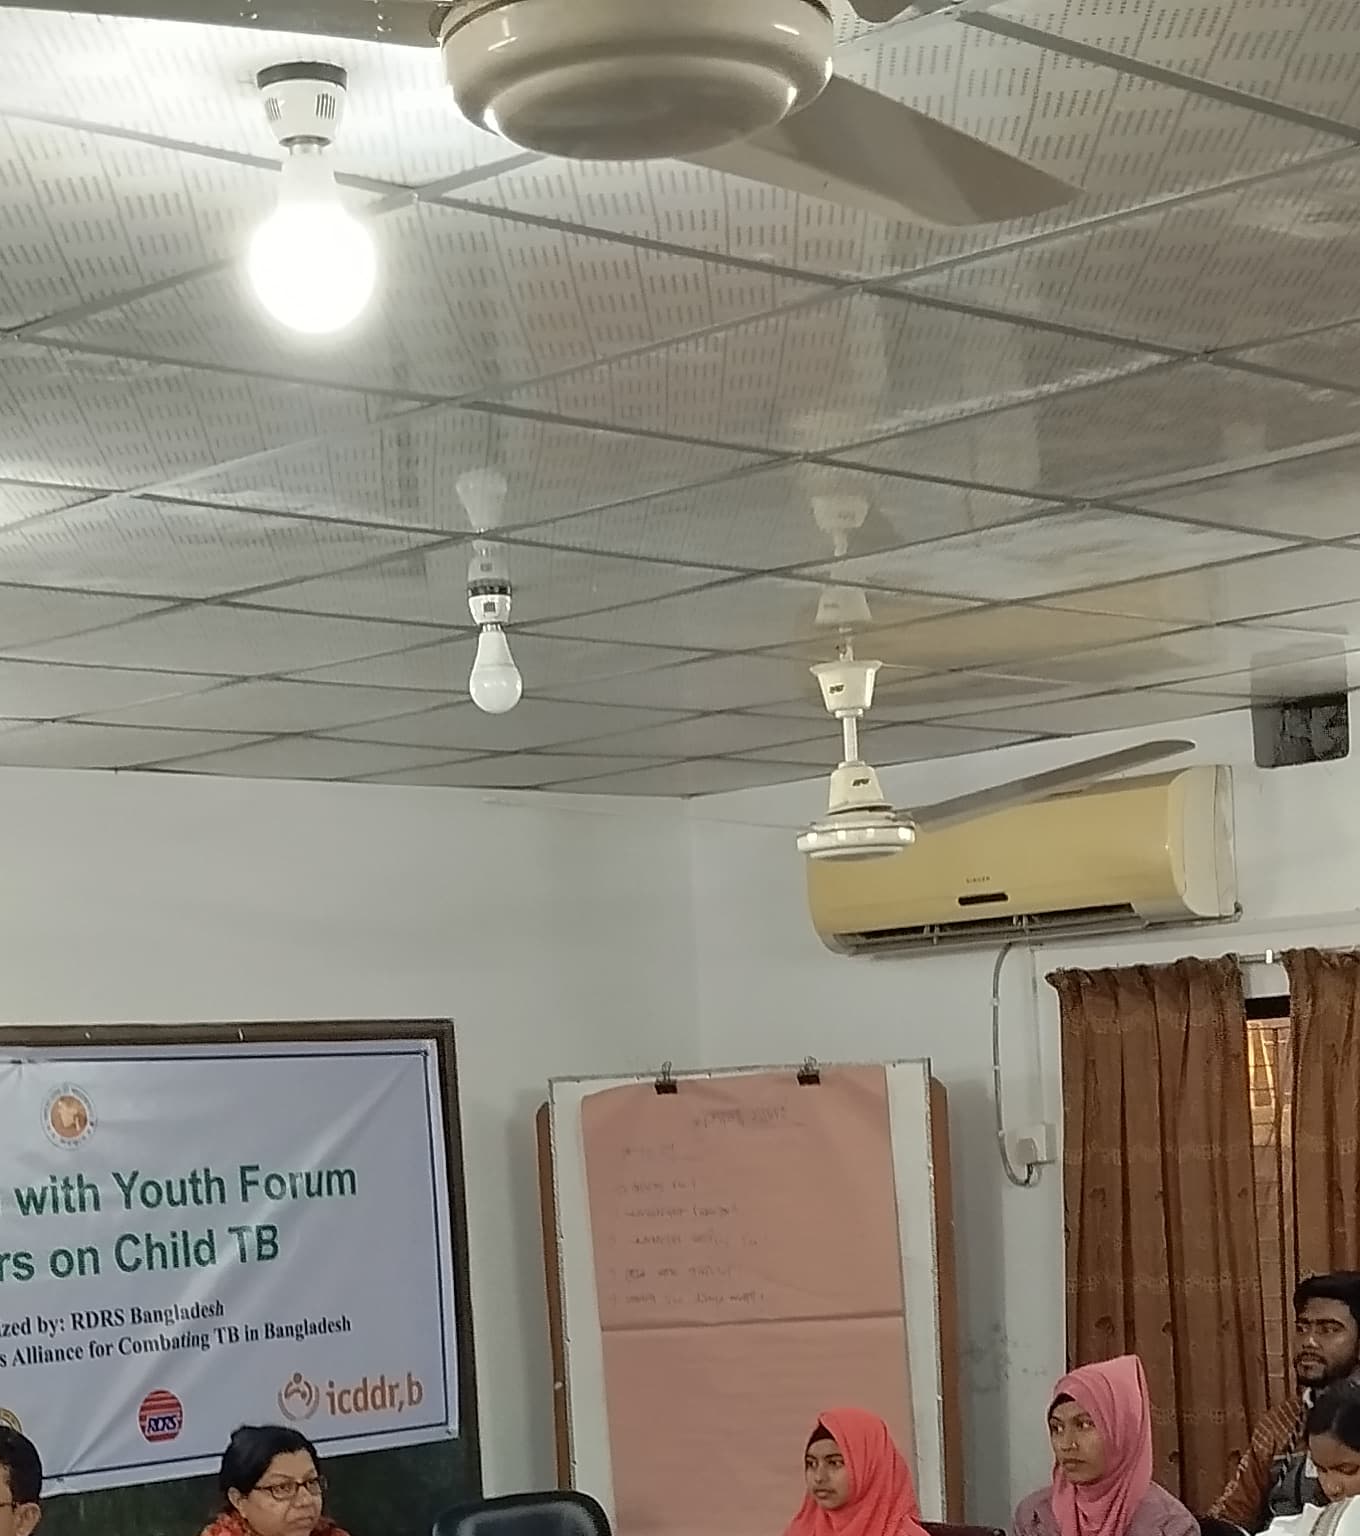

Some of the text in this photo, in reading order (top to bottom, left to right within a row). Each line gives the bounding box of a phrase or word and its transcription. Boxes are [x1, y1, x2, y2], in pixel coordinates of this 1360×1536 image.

[14, 1173, 101, 1217] with
[112, 1167, 227, 1210] Youth
[240, 1163, 357, 1203] Forum
[49, 1244, 100, 1278] on
[114, 1228, 217, 1273] Child
[228, 1223, 279, 1264] TB
[12, 1344, 84, 1367] Alliance
[89, 1340, 113, 1360] for
[118, 1331, 211, 1356] Combating
[213, 1325, 240, 1345] TB
[244, 1324, 260, 1342] in
[264, 1315, 352, 1341] Bangladesh
[38, 1314, 65, 1338] by:
[70, 1307, 125, 1332] RDRS
[130, 1299, 225, 1326] Bangladesh
[326, 1372, 424, 1415] icddr,b
